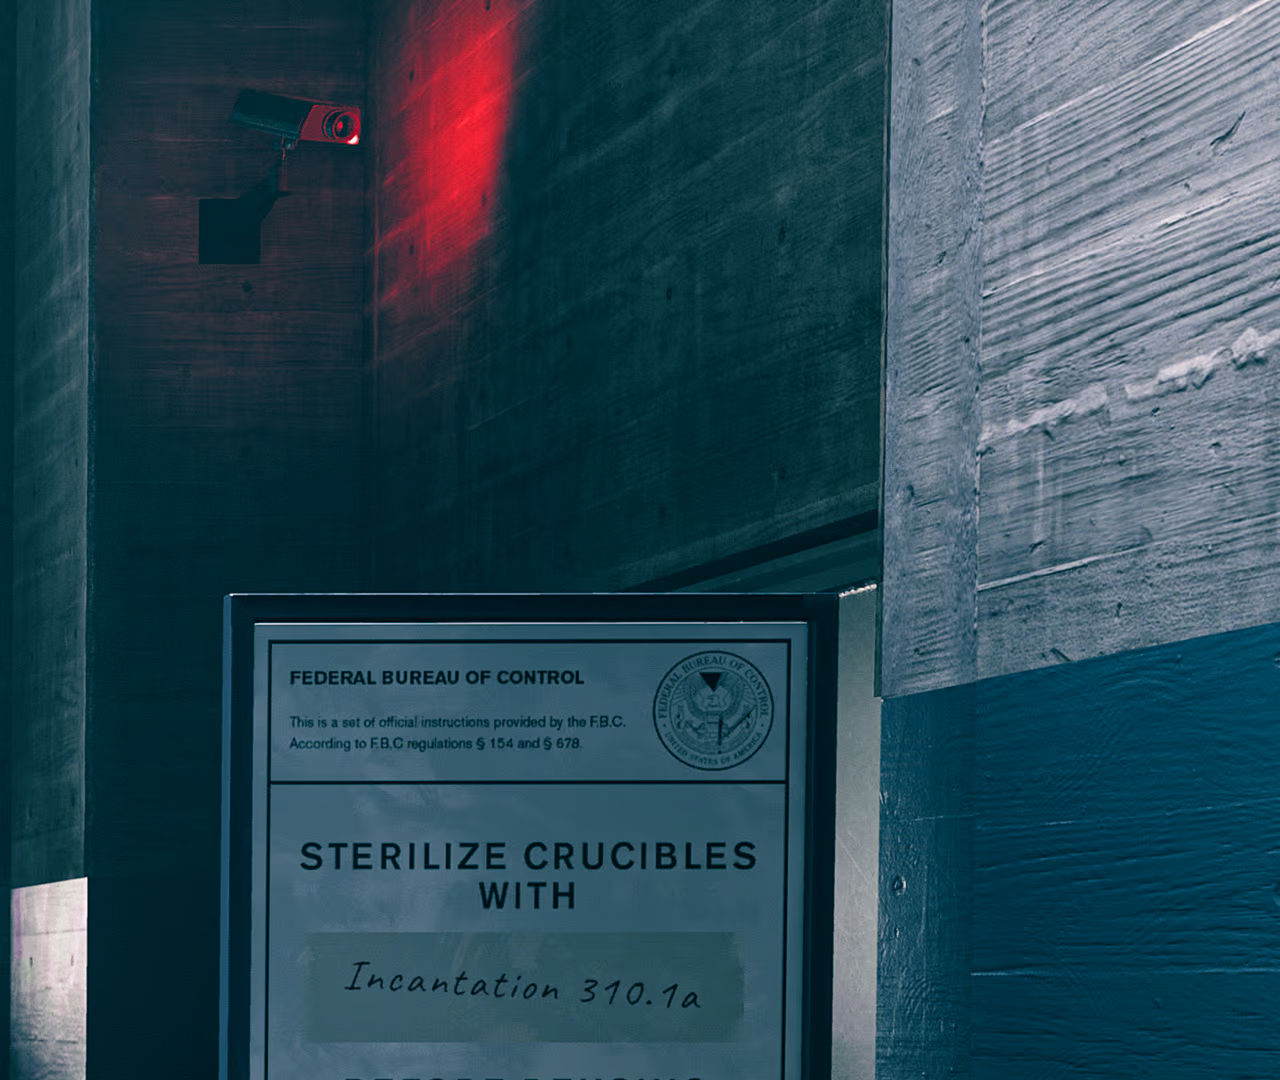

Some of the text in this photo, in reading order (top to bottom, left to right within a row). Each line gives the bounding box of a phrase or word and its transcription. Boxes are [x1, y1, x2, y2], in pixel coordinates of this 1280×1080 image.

[289, 669, 585, 686] FEDERAL BUREAU OF CONTROL
[658, 655, 770, 719] FEDERAL BUREAU OF CONTROL
[289, 714, 627, 732] This is a set of official instructions provided by the F.B.C.
[289, 736, 583, 753] According to F.B.C regulations § 154 and § 678.
[690, 753, 719, 765] STATES
[299, 841, 757, 871] STERILIZE CRUCIBLES
[478, 881, 576, 910] WITH
[344, 961, 702, 1009] Incantation 310.1a
